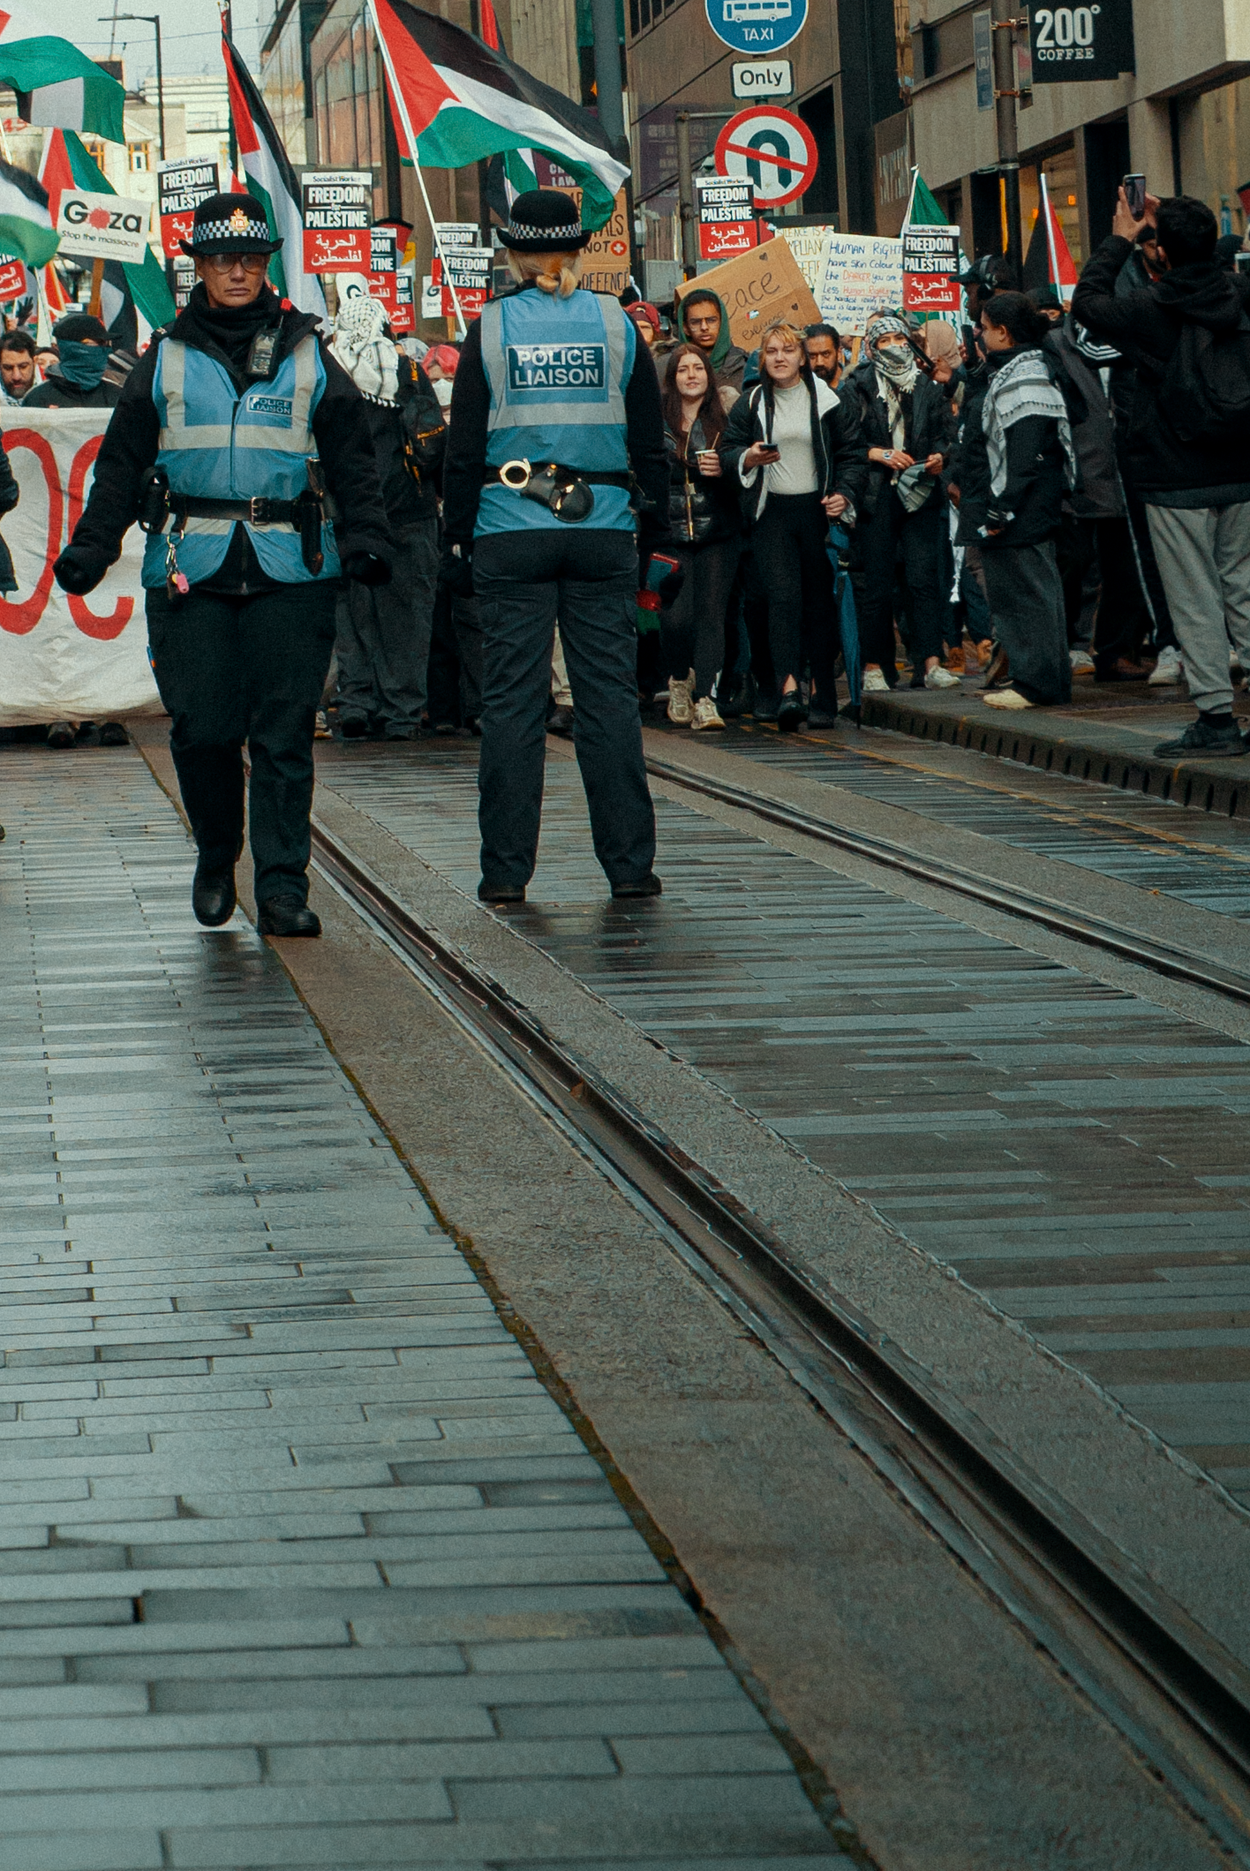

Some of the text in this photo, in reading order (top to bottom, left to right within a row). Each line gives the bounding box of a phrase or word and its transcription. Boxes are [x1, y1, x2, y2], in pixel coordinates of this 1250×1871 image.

[742, 28, 774, 41] TAXI
[1037, 48, 1095, 61] COFFEE
[740, 69, 783, 86] Only
[163, 166, 214, 190] FREEDOM
[308, 186, 365, 204] FREEDOM
[702, 187, 749, 203] FREEDOM
[305, 210, 368, 228] PALESTINE
[701, 206, 752, 223] PALESTINE
[62, 230, 140, 248] Stop the massacre
[315, 234, 356, 250] الحرية
[905, 237, 953, 252] FREEDOM
[583, 241, 611, 254] NOT
[830, 240, 865, 255] HUMAN
[446, 257, 489, 271] FREEDOM
[904, 257, 957, 273] PALESTINE
[825, 270, 839, 281] the
[720, 272, 780, 320] eace
[516, 349, 596, 367] POLICE
[515, 368, 599, 386] LIAISON
